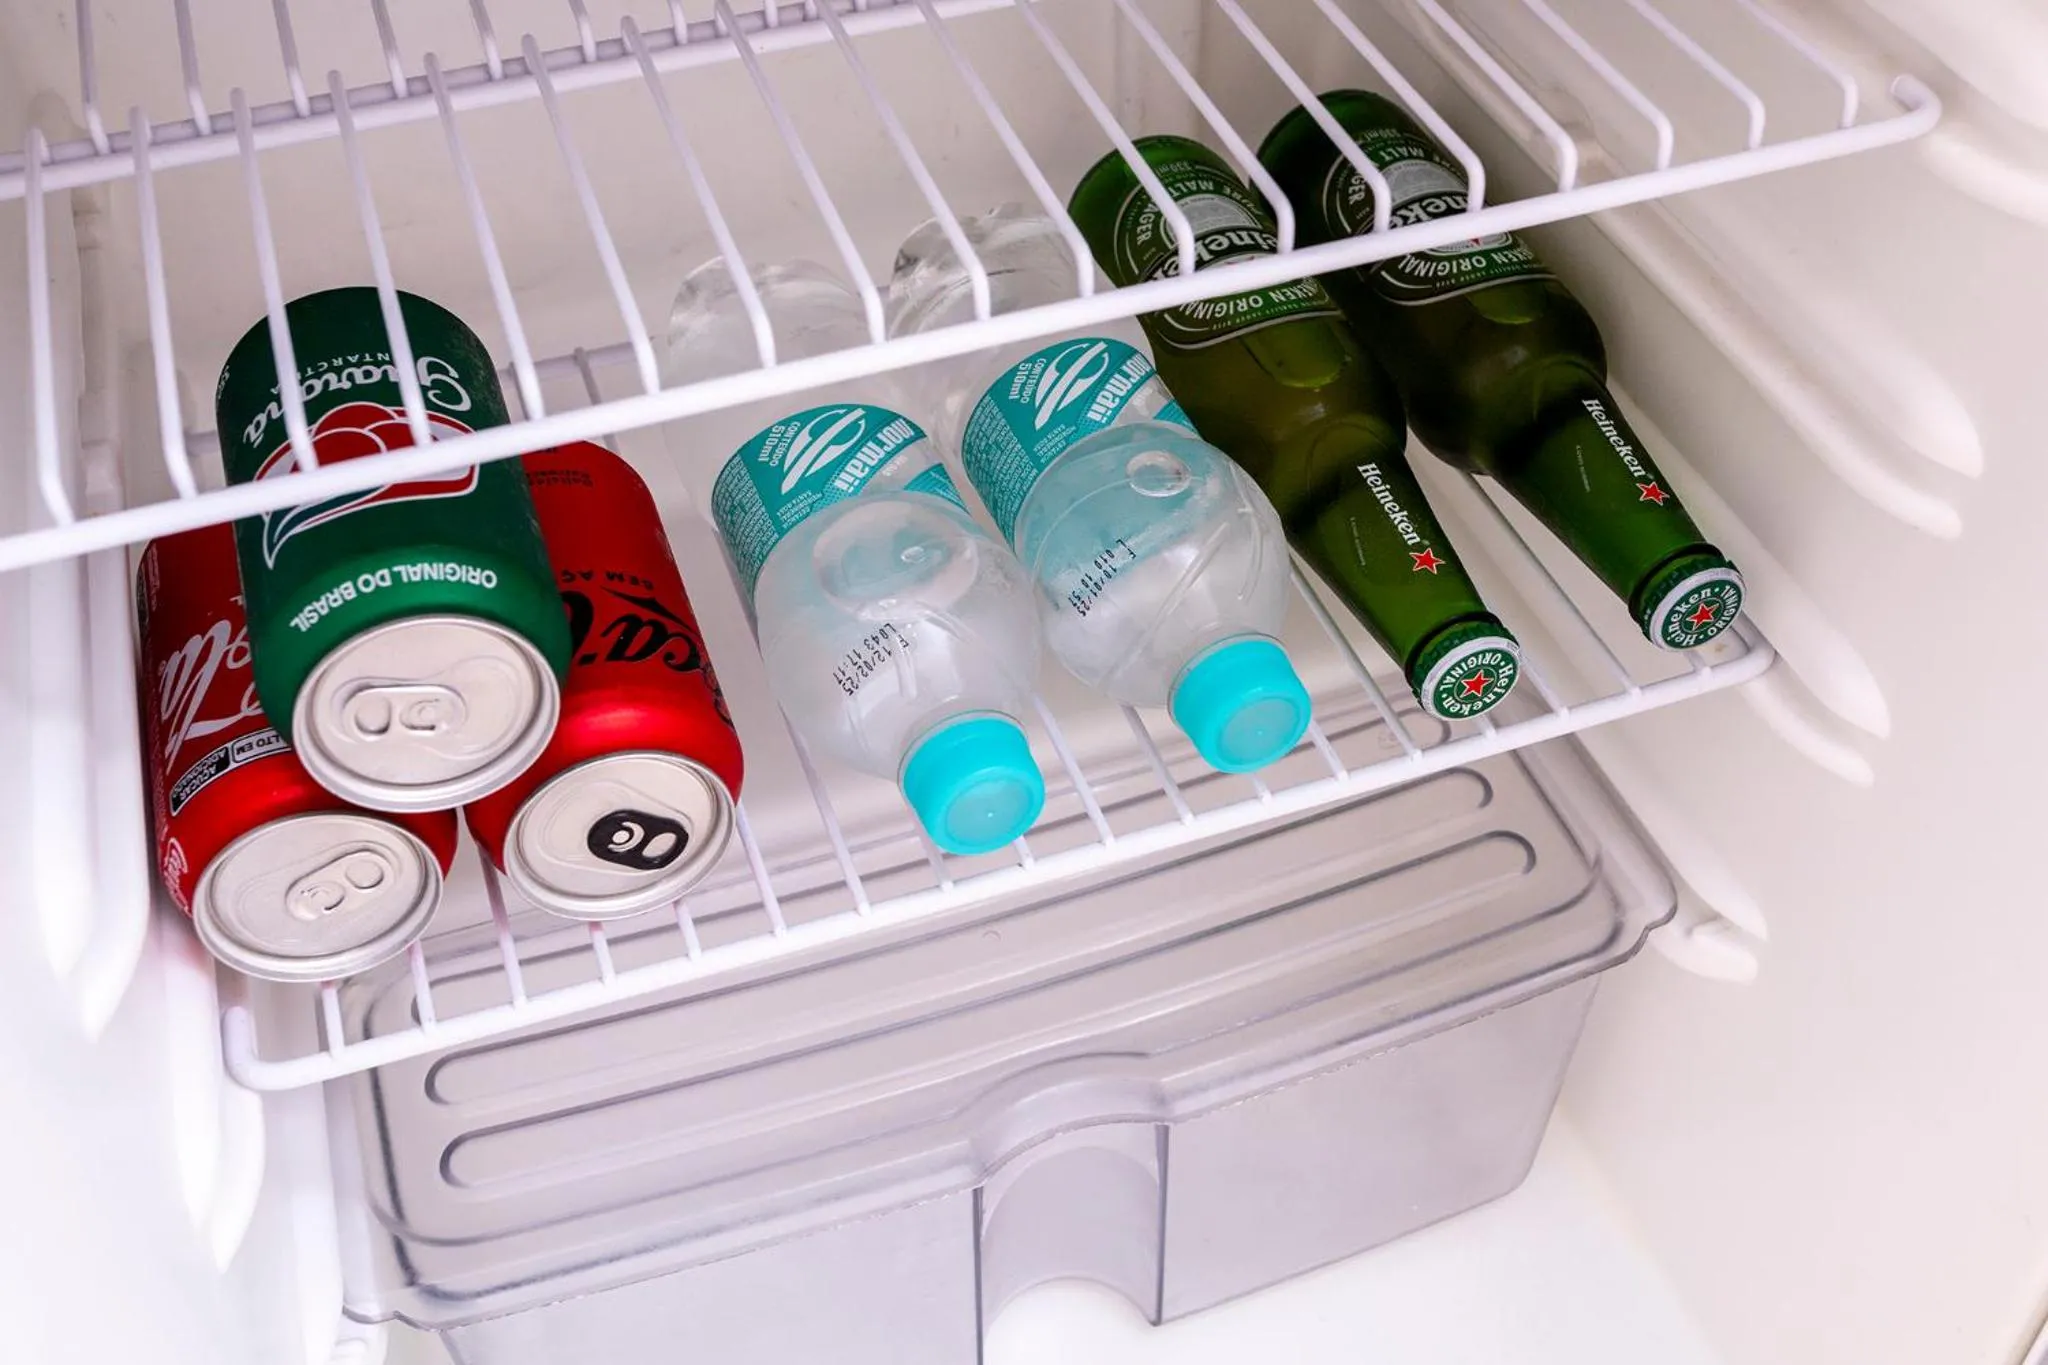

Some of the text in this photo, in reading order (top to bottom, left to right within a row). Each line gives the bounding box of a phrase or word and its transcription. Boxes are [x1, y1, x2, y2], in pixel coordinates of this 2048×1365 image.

[1171, 180, 1215, 199] MALT
[1348, 170, 1366, 205] GER
[1009, 362, 1032, 400] 510ml
[758, 425, 786, 462] 510ml
[833, 417, 916, 493] mormaii
[1582, 398, 1646, 478] Heineken
[1357, 462, 1421, 546] Heineken
[289, 562, 497, 633] ORIGINAL DO BRASIL
[606, 570, 654, 591] SEM
[1667, 584, 1737, 647] Heineken ORIGINAL
[842, 646, 893, 697] 12/02/25
[1438, 651, 1514, 716] ORIGINAL Heineken
[256, 734, 281, 748] LTO
